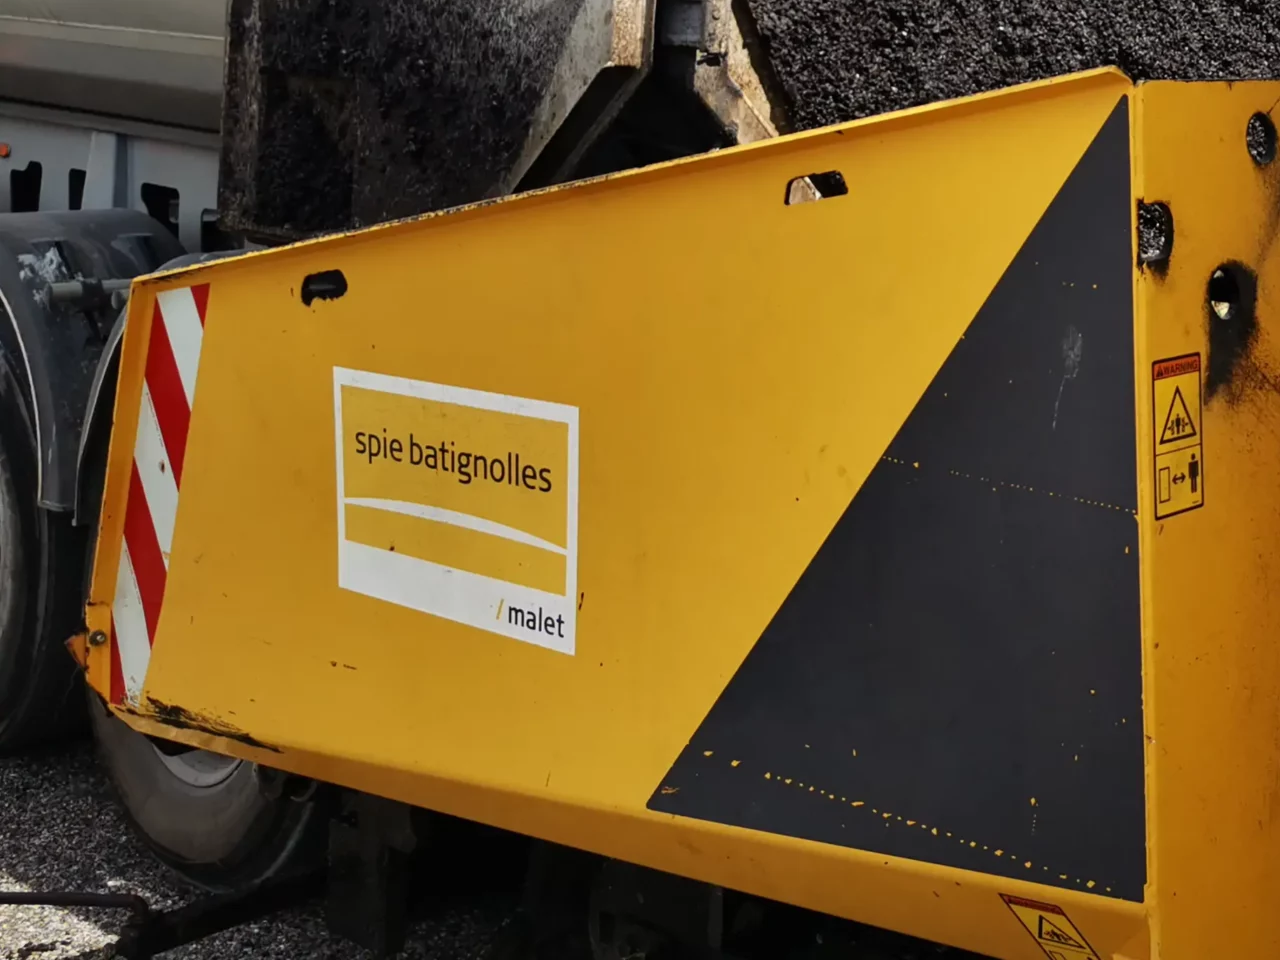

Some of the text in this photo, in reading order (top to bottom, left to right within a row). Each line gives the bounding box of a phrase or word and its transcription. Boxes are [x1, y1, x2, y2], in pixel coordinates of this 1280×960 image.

[1163, 358, 1198, 375] WARNING
[355, 427, 552, 493] spie batignolles
